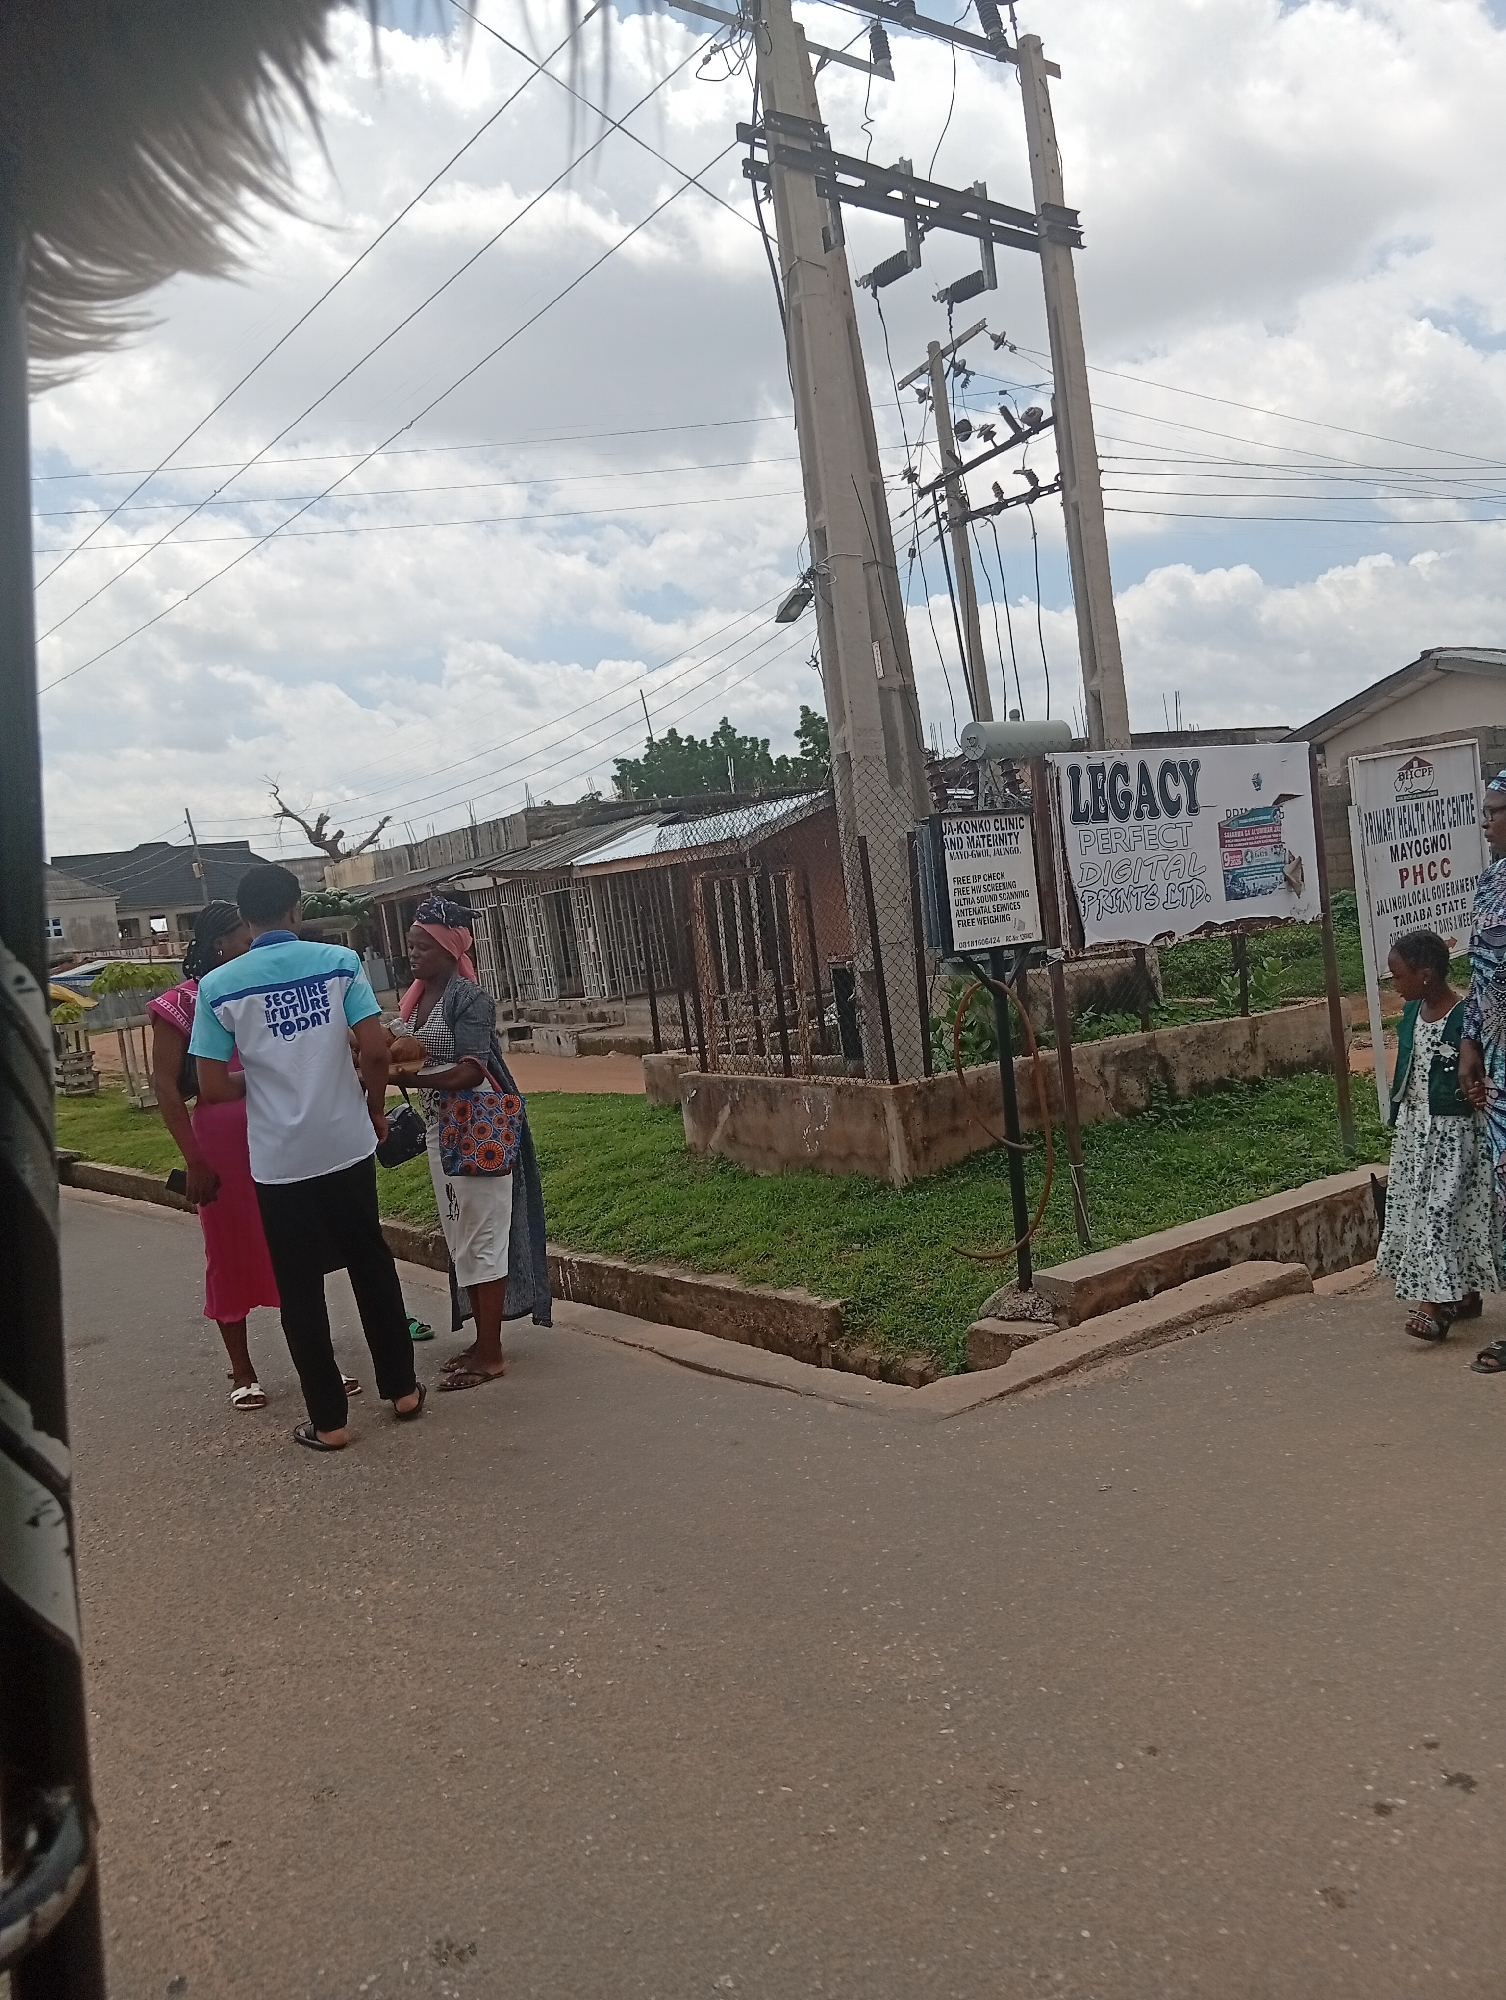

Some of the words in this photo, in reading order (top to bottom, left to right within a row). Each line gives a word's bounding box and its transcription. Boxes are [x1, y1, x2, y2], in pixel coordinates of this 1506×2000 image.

[1067, 758, 1201, 825] LEGACY
[993, 816, 1025, 831] CLINIC
[1364, 807, 1395, 846] PRIMARY
[1397, 800, 1427, 839] HEALTH
[1427, 797, 1445, 834] CARE
[1446, 793, 1476, 829] CENTRE
[943, 836, 963, 850] AND
[966, 832, 1020, 849] MATERNITY
[1079, 822, 1193, 856] PERFECT
[1390, 832, 1452, 864] MAYOGWOI
[1077, 853, 1206, 888] DIGITAL
[1223, 852, 1230, 867] 9
[1398, 857, 1452, 889] PHCC
[953, 875, 971, 886] FREE
[972, 874, 981, 883] BP
[983, 872, 1005, 881] CHECK
[954, 886, 970, 897] FREE
[983, 881, 1017, 892] SCREENING
[954, 896, 975, 907] ULTRA
[977, 894, 998, 904] SOUND
[999, 890, 1029, 901] SCANNING
[956, 906, 991, 918] ANTENATAL
[992, 902, 1021, 913] SERVICES
[1079, 883, 1160, 923] PRINTS
[1164, 878, 1212, 911] LTD.
[1376, 894, 1407, 916] JALINGO
[1407, 887, 1432, 907] LOCAL
[1393, 907, 1433, 927] TARABA
[1436, 898, 1467, 916] STATE
[957, 918, 976, 928] FREE
[977, 914, 1011, 925] WEIGHING
[264, 981, 328, 1009] SECURE
[271, 995, 331, 1022] FUTURE
[268, 1008, 331, 1037] TODAY
